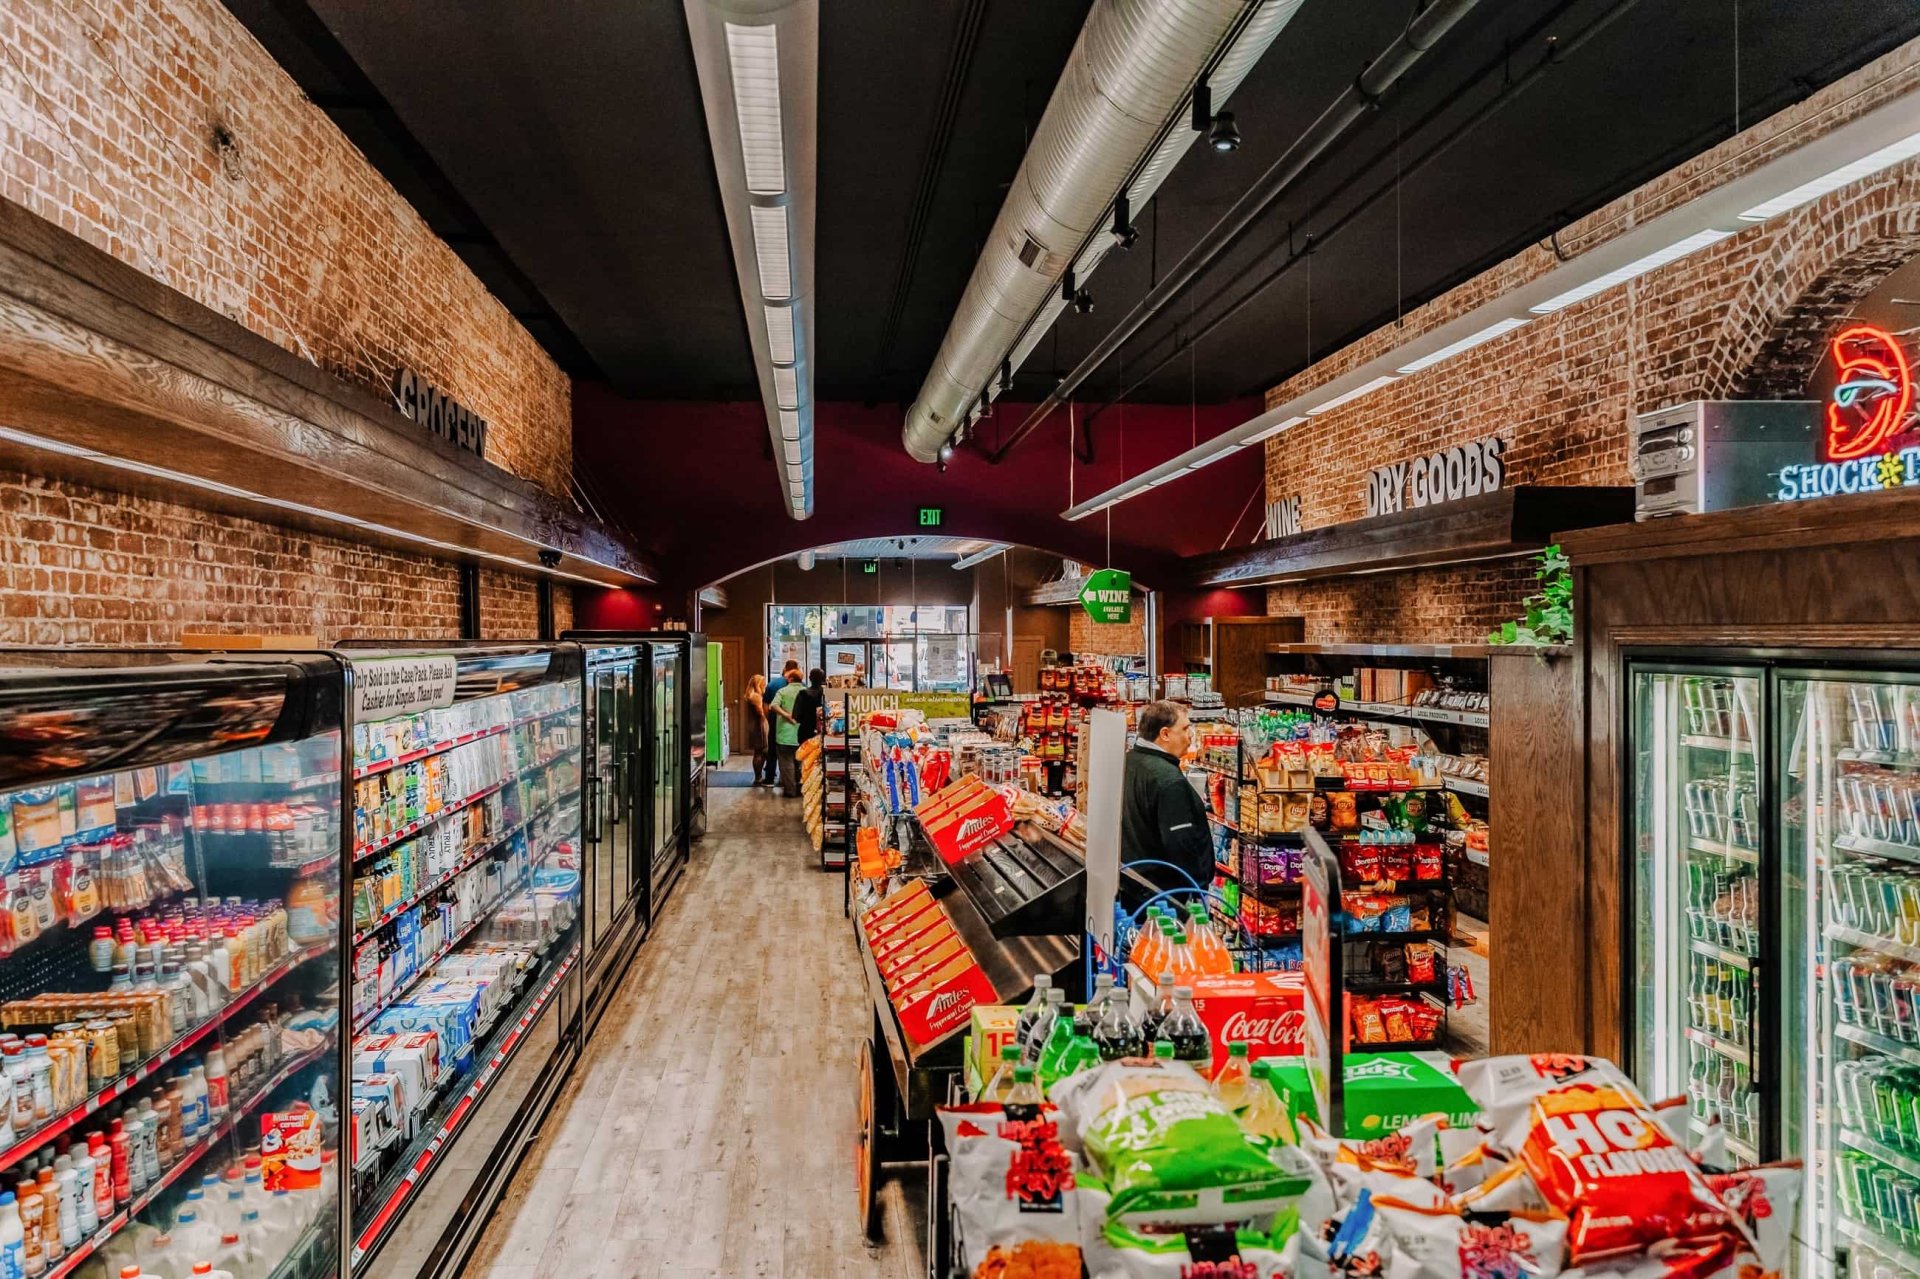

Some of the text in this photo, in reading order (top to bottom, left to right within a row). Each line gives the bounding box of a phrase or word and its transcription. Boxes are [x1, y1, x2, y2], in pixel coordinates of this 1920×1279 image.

[398, 368, 487, 459] GROCERY
[1366, 437, 1503, 517] DRY GOODS
[1778, 446, 1920, 502] SHOCK T
[920, 509, 941, 525] EXIT
[1265, 495, 1301, 540] WINE
[1097, 589, 1129, 603] WINE
[1102, 605, 1124, 613] AVAILABLE
[369, 666, 382, 687] Sold
[383, 667, 389, 685] in
[391, 665, 399, 685] the
[428, 663, 443, 681] Please
[444, 662, 453, 679] Ask
[362, 690, 385, 712] Cashier
[385, 688, 394, 708] for
[416, 682, 433, 702] Thank
[848, 695, 899, 713] MUNCH
[906, 695, 927, 703] snack
[1428, 711, 1448, 720] PRODUCTS
[1477, 786, 1488, 794] LOCA
[957, 814, 994, 842] Andes
[428, 836, 436, 860] TRULY
[443, 830, 451, 853] TRULY
[926, 986, 969, 1020] Andes
[1194, 999, 1205, 1009] 15
[1221, 1010, 1305, 1046] Coca-Col
[1344, 1063, 1401, 1078] Spri
[1548, 1110, 1654, 1158] HO
